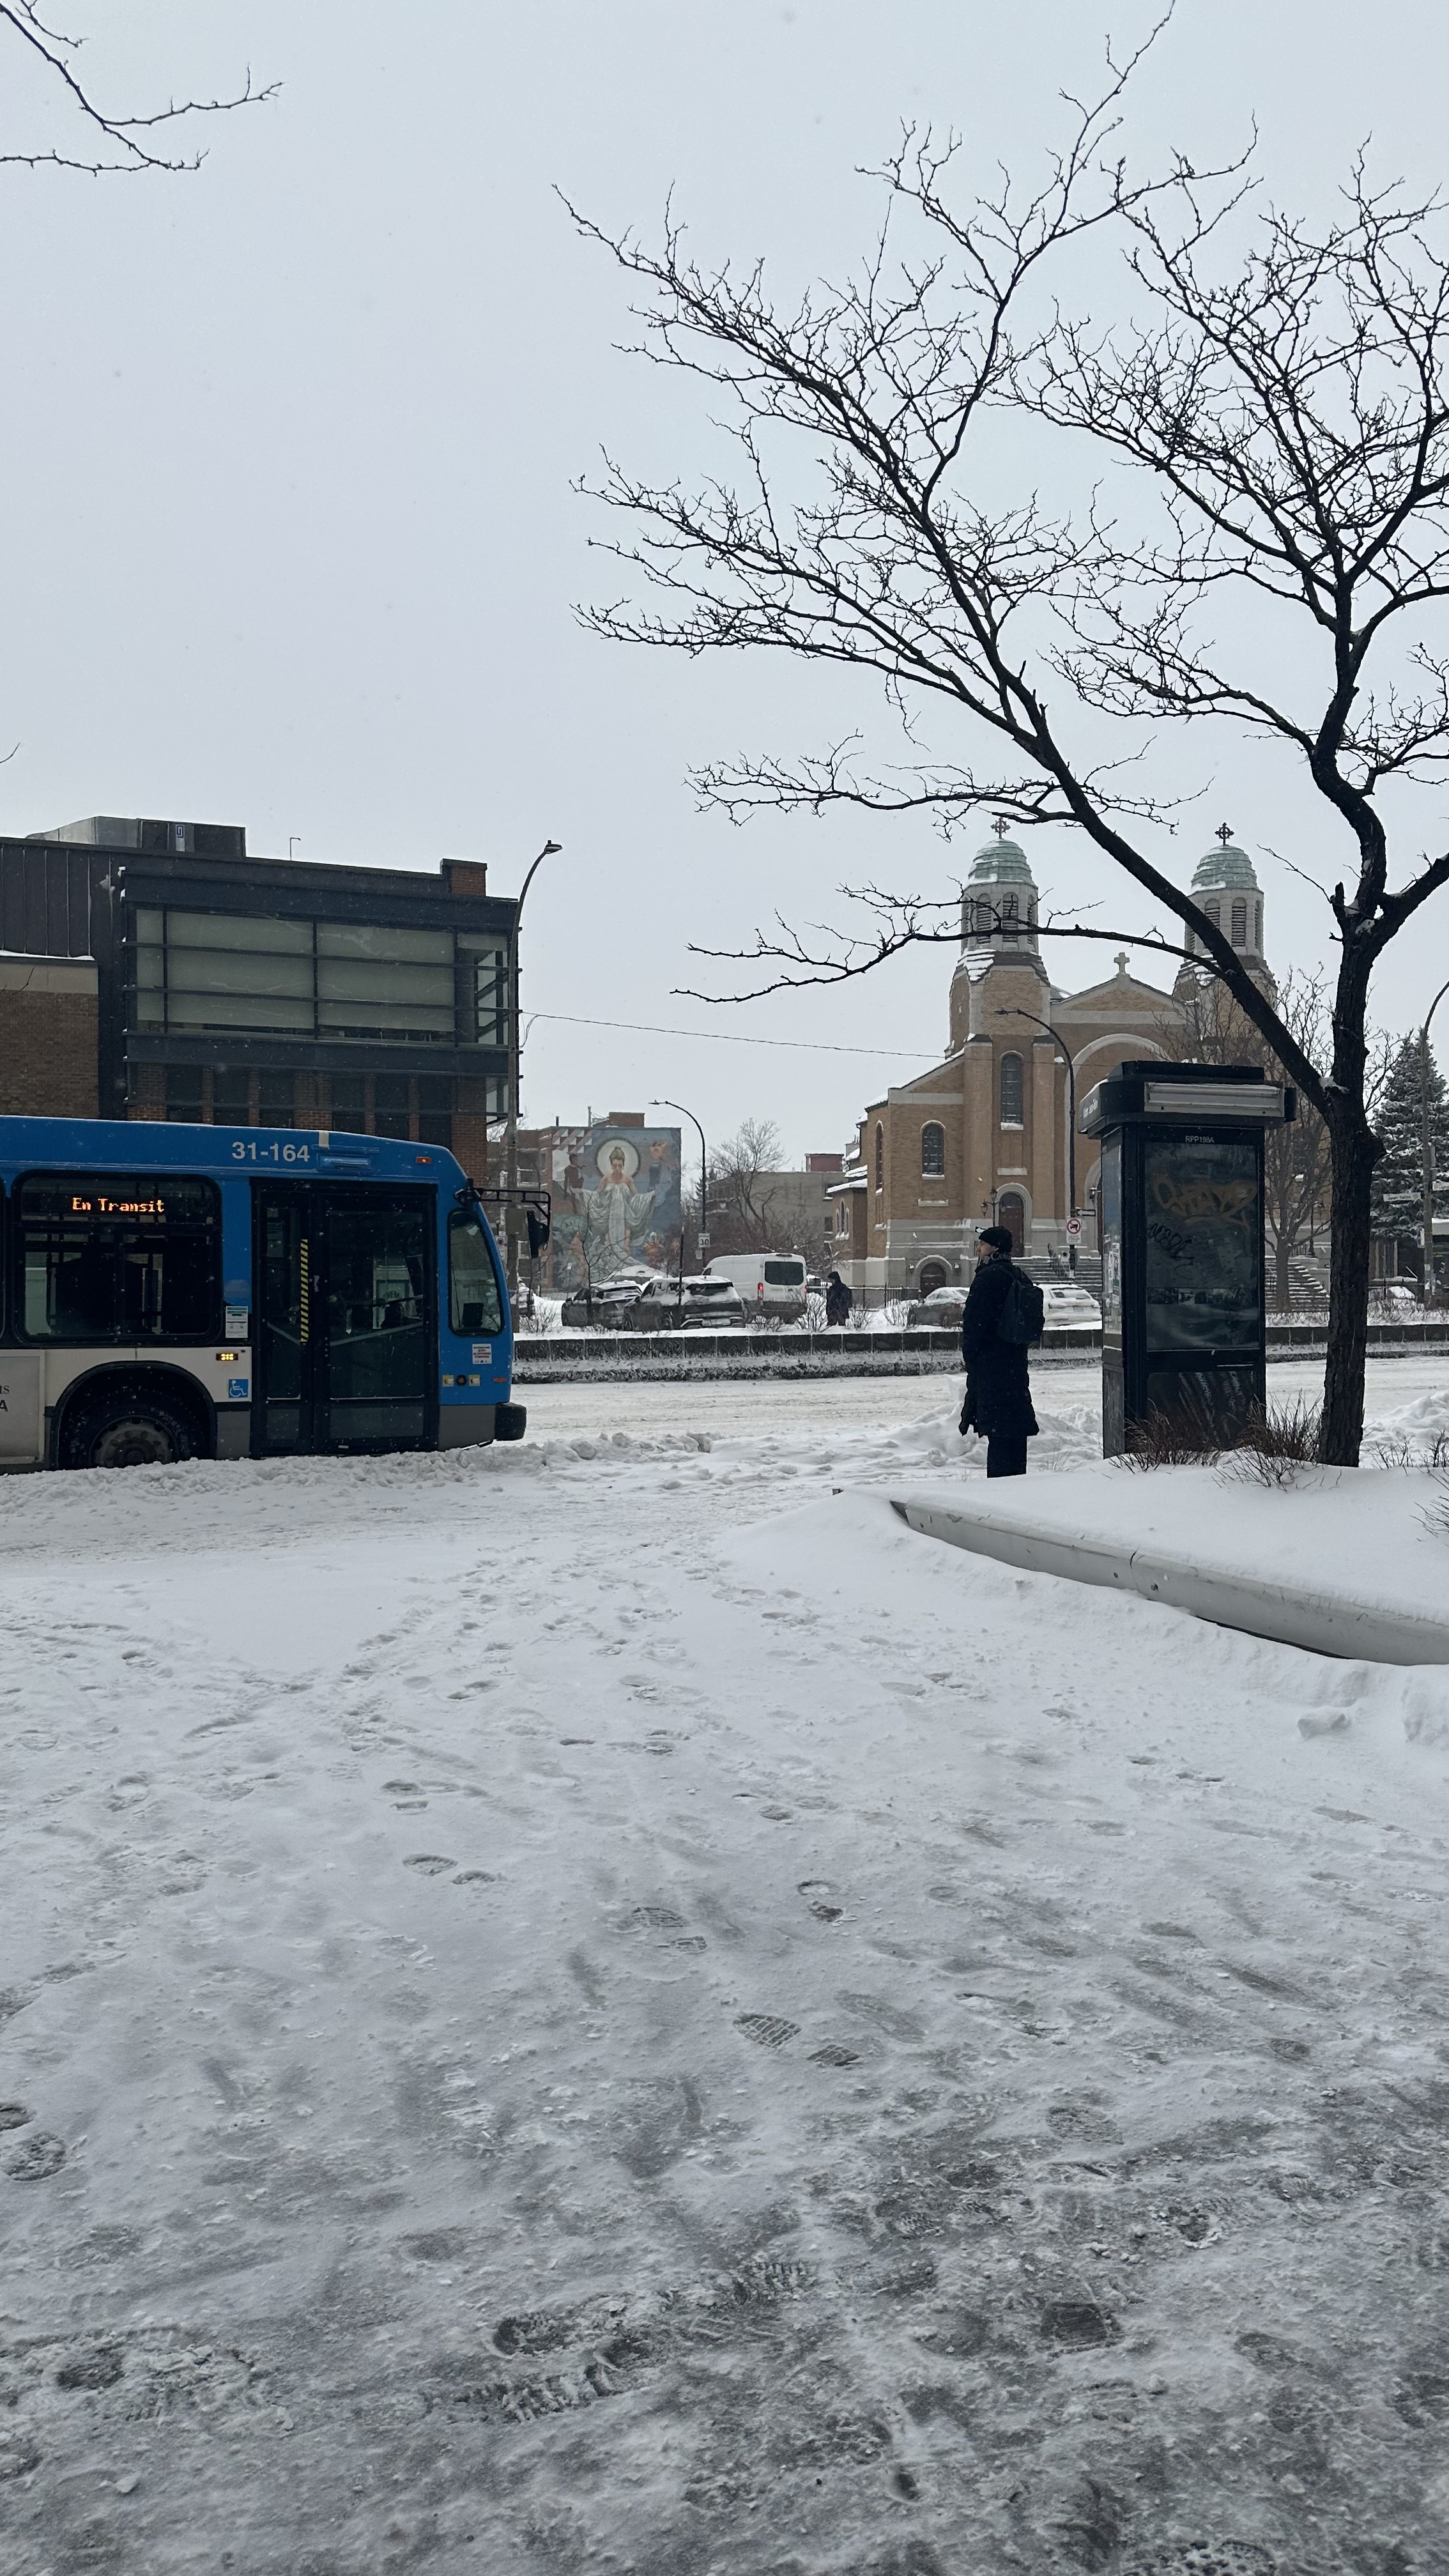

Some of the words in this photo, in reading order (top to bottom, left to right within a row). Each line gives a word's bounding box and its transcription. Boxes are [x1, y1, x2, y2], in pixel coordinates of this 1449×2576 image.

[232, 1141, 310, 1162] 31-164
[72, 1197, 91, 1210] En
[97, 1198, 164, 1212] Transit
